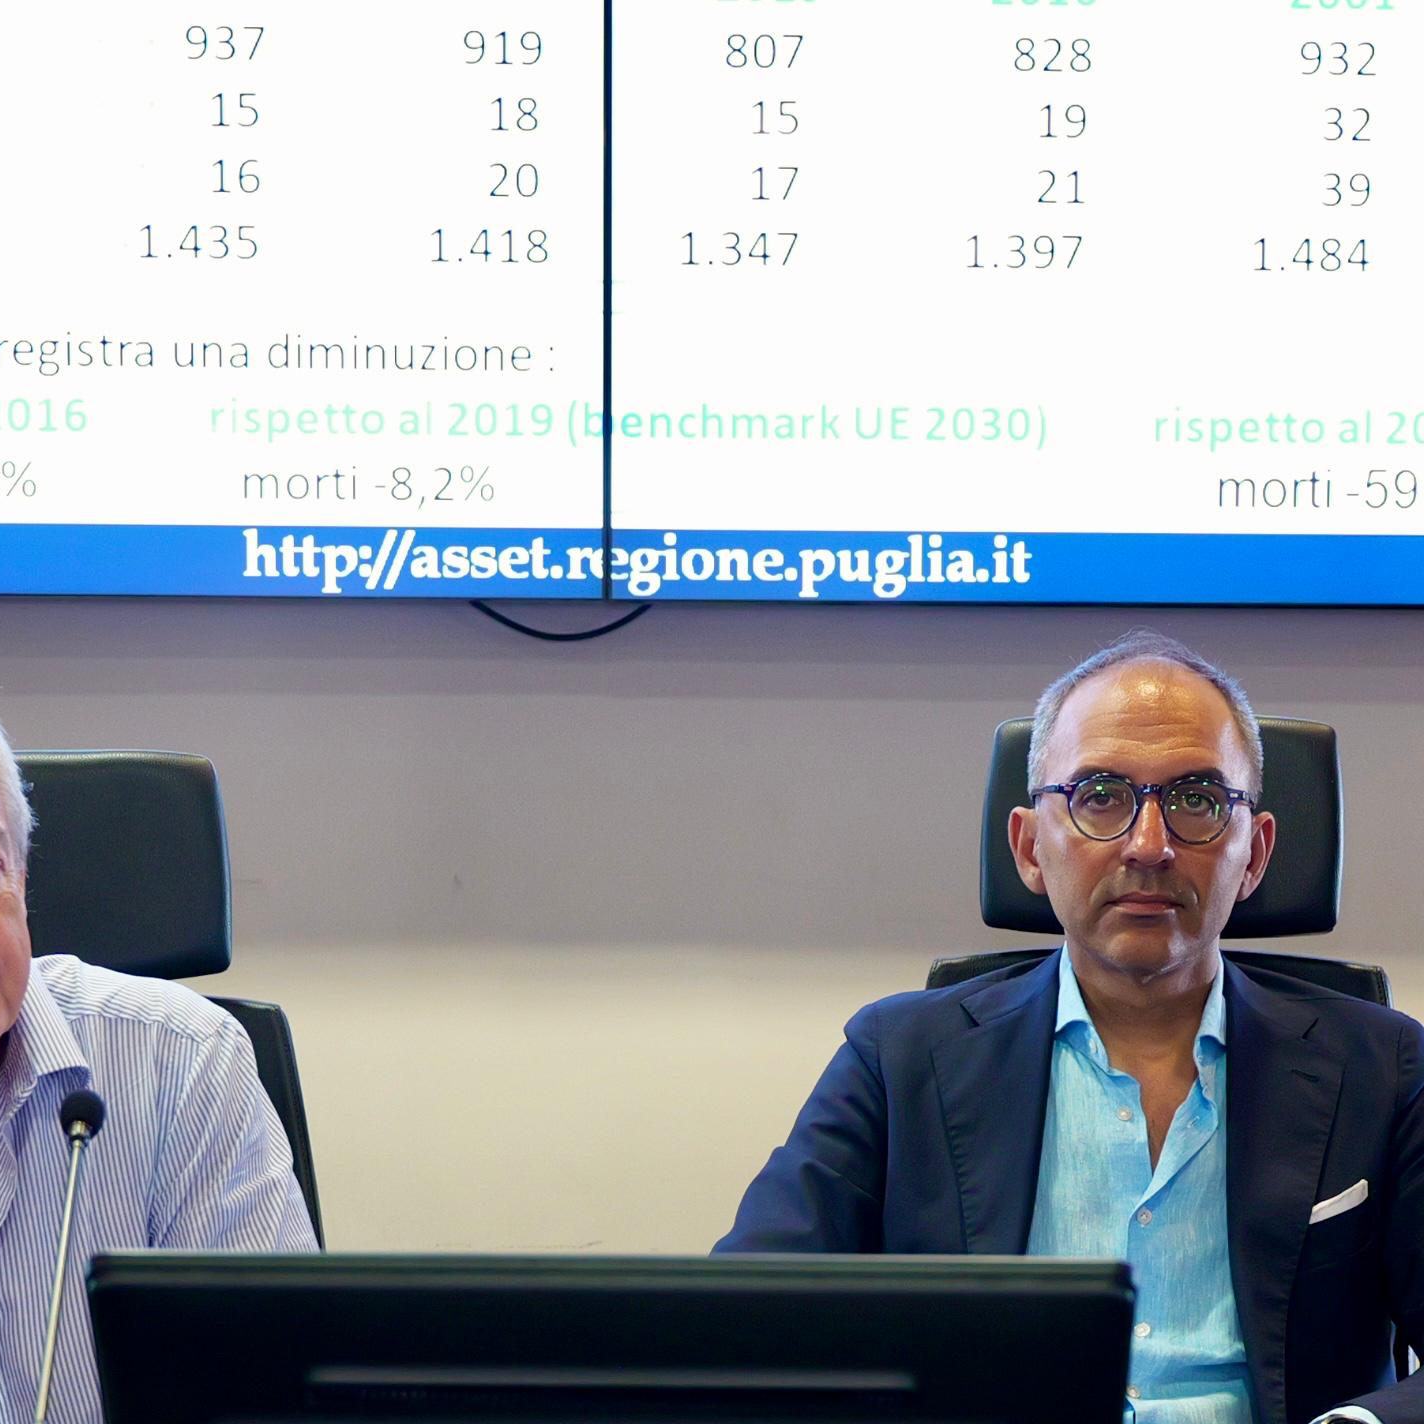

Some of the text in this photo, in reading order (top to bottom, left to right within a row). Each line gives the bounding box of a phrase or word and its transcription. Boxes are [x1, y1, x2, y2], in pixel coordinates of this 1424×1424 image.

[186, 25, 266, 61] 937
[464, 30, 544, 65] 919
[726, 33, 804, 68] 807
[1014, 37, 1091, 72] 828
[1301, 41, 1377, 76] 932
[211, 92, 260, 127] 15
[490, 96, 540, 131] 18
[751, 101, 799, 135] 15
[1039, 104, 1088, 138] 19
[1323, 107, 1372, 142] 32
[211, 159, 261, 194] 16
[489, 162, 540, 197] 20
[751, 166, 799, 201] 17
[1037, 169, 1085, 204] 21
[1322, 173, 1372, 207] 39
[139, 224, 260, 260] 1.435
[430, 228, 550, 263] 1.418
[680, 231, 799, 267] 1.347
[966, 234, 1083, 270] 1.397
[1252, 237, 1370, 273] 1.484
[174, 342, 250, 370] una
[268, 332, 533, 372] diminuzione
[210, 398, 1048, 451] rispetto al 2019 (benchmark UE 2030)
[1154, 407, 1326, 453] rispetto
[1337, 409, 1372, 445] al
[243, 465, 495, 511] morti -8,2%
[1218, 470, 1332, 509] morti
[243, 529, 1031, 597] http://asset.regione.puglia.it
